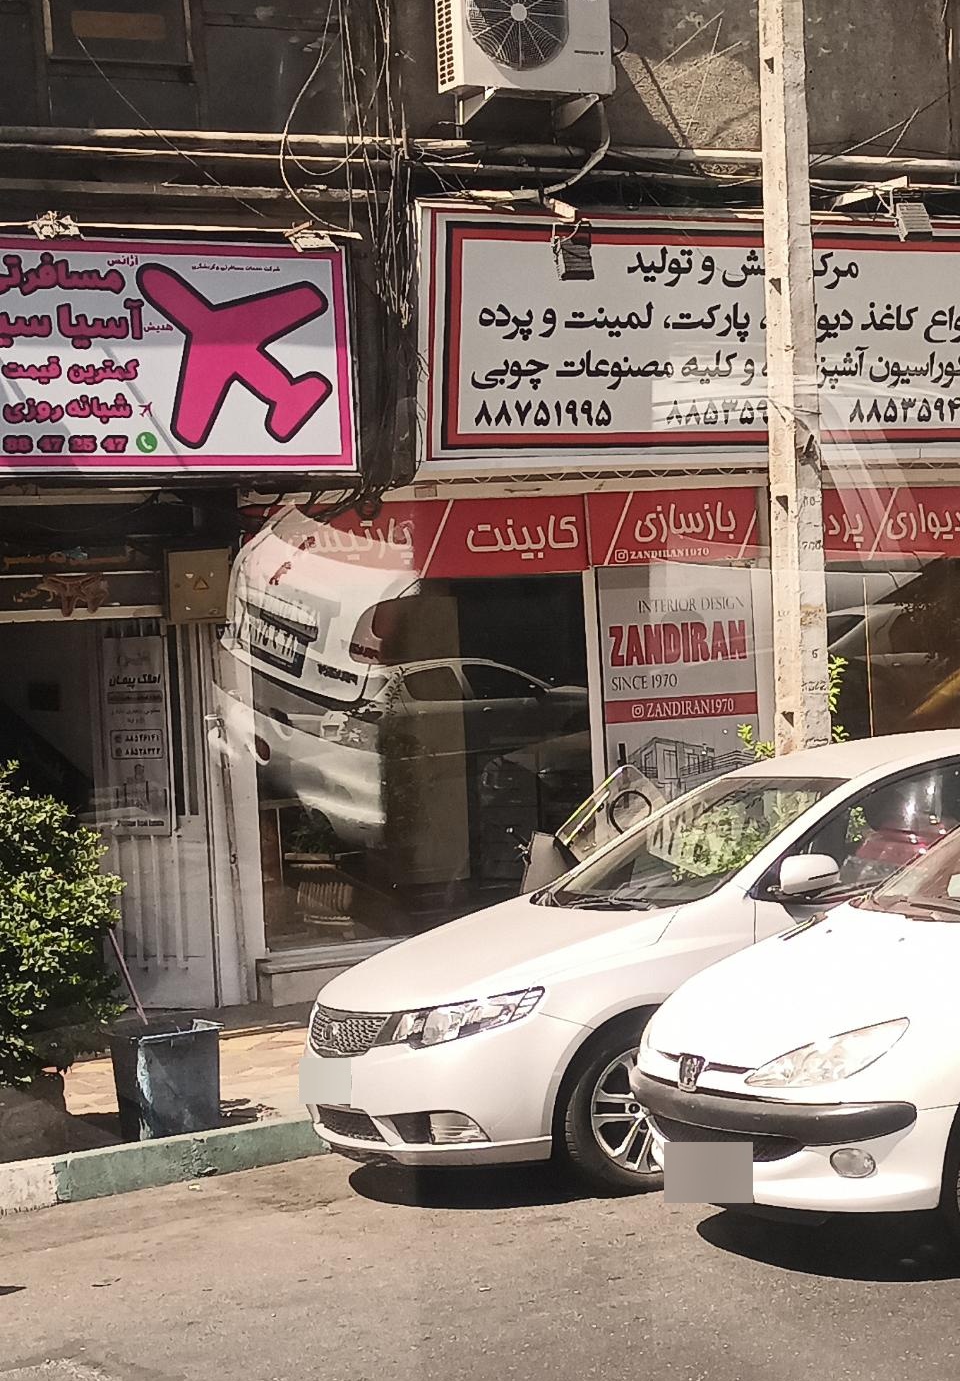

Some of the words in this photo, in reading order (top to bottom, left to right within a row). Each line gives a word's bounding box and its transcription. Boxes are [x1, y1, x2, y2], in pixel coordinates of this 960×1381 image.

[0, 252, 126, 296] مسافرت
[626, 246, 693, 287] تولید
[697, 254, 716, 285] و
[813, 252, 860, 290] مرک
[56, 298, 144, 349] آسیا
[478, 303, 534, 341] پرده
[538, 307, 557, 338] و
[564, 301, 654, 337] لمینت
[861, 301, 919, 331] کاغذ
[1, 355, 62, 385] قیمت
[67, 359, 140, 385] کمترین
[471, 358, 550, 390] چوبی
[555, 349, 674, 390] مصنوعات
[681, 349, 738, 385] کلیه
[740, 358, 755, 386] و
[2, 398, 65, 424] روزی
[65, 393, 133, 424] شبانه
[474, 399, 612, 427] ۸۸۷۵۱۹۹۵
[465, 514, 580, 560] کابینت
[633, 500, 738, 545] بازسازی
[822, 509, 865, 548] پرد
[638, 597, 698, 614] INTERIOR
[701, 596, 745, 611] DESIGN
[608, 619, 748, 667] ZANDIRAN
[611, 674, 649, 691] SINCE
[651, 673, 678, 689] 1970
[646, 697, 735, 718] ZANDIRAN1970
